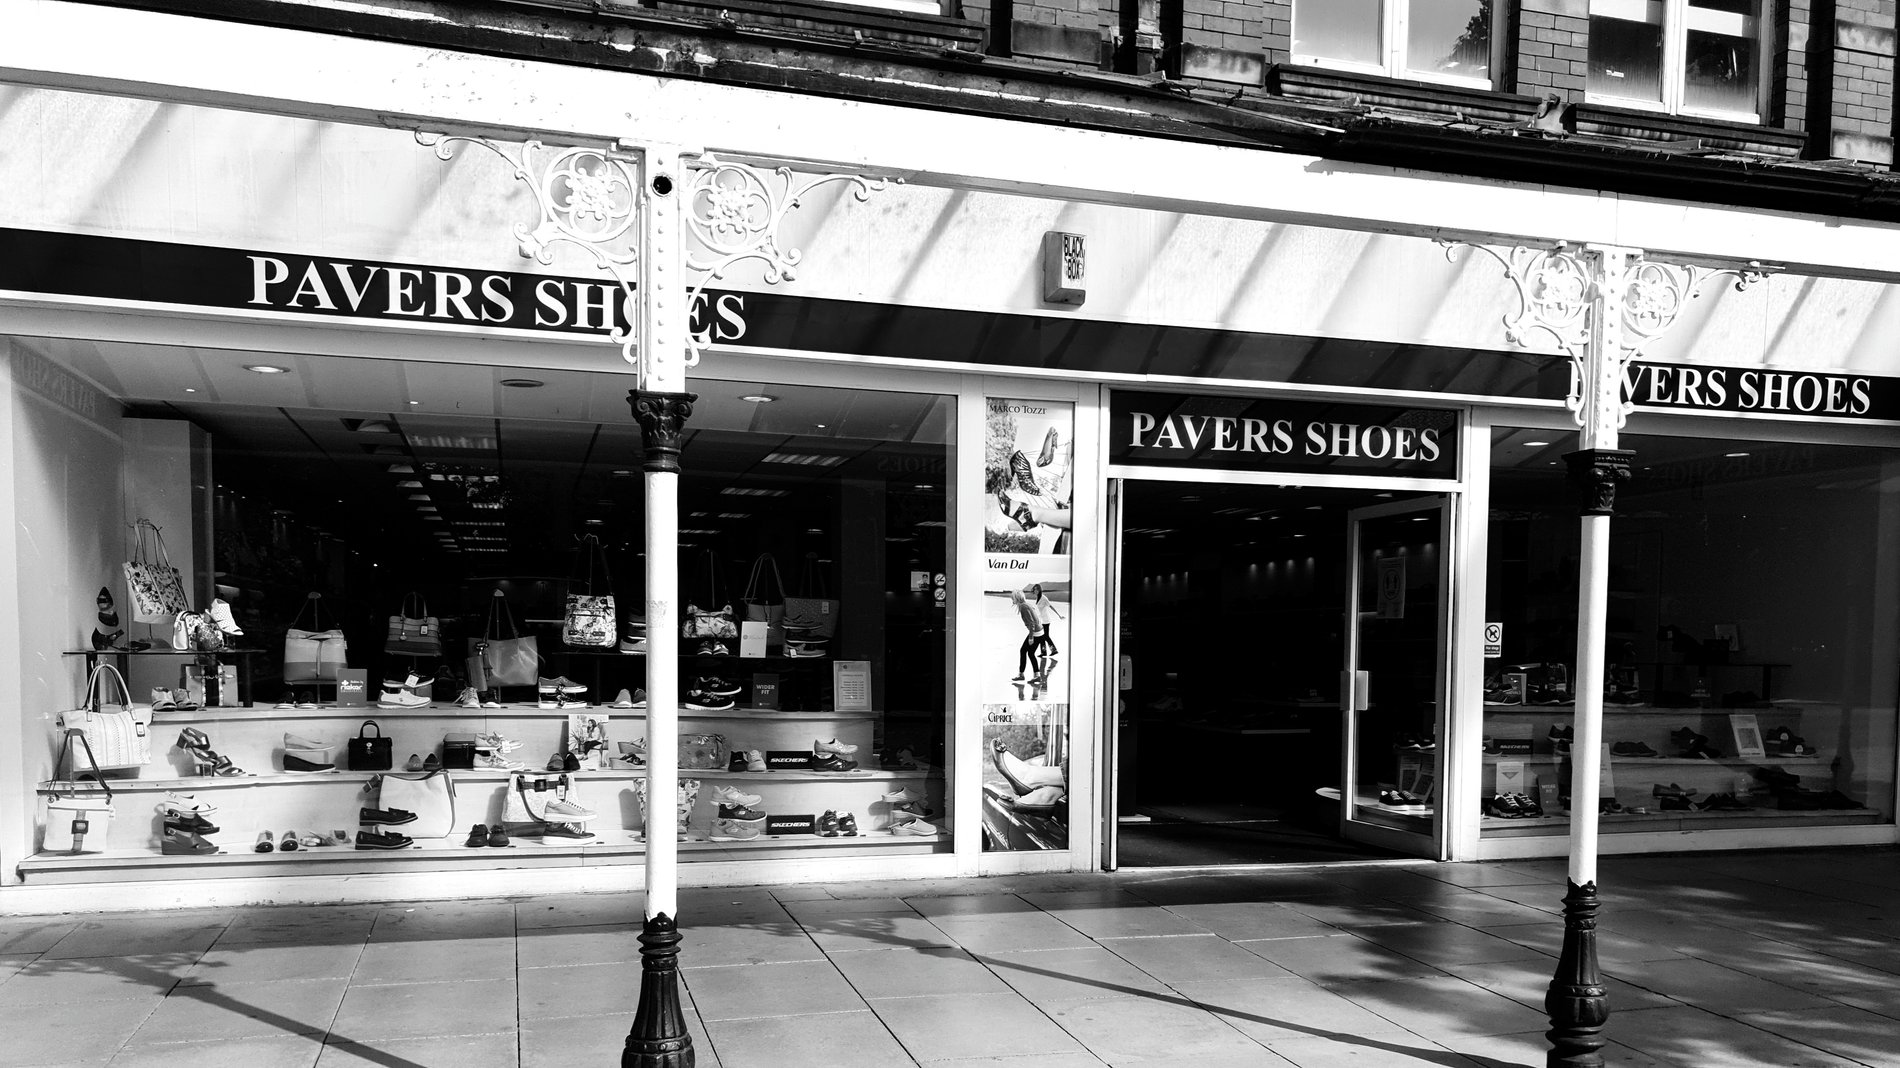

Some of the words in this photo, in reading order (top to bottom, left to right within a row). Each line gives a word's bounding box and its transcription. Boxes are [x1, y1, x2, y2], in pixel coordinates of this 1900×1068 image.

[1064, 235, 1085, 258] BLACK
[1068, 258, 1081, 280] BOX
[246, 256, 515, 323] PAVERS
[1566, 361, 1728, 407] VERS
[1738, 372, 1871, 415] SHOES
[989, 404, 1020, 414] MARCO
[1128, 412, 1294, 455] PAVERS
[1305, 422, 1441, 462] SHOES
[988, 558, 1008, 569] Van
[1010, 559, 1030, 570] Dal
